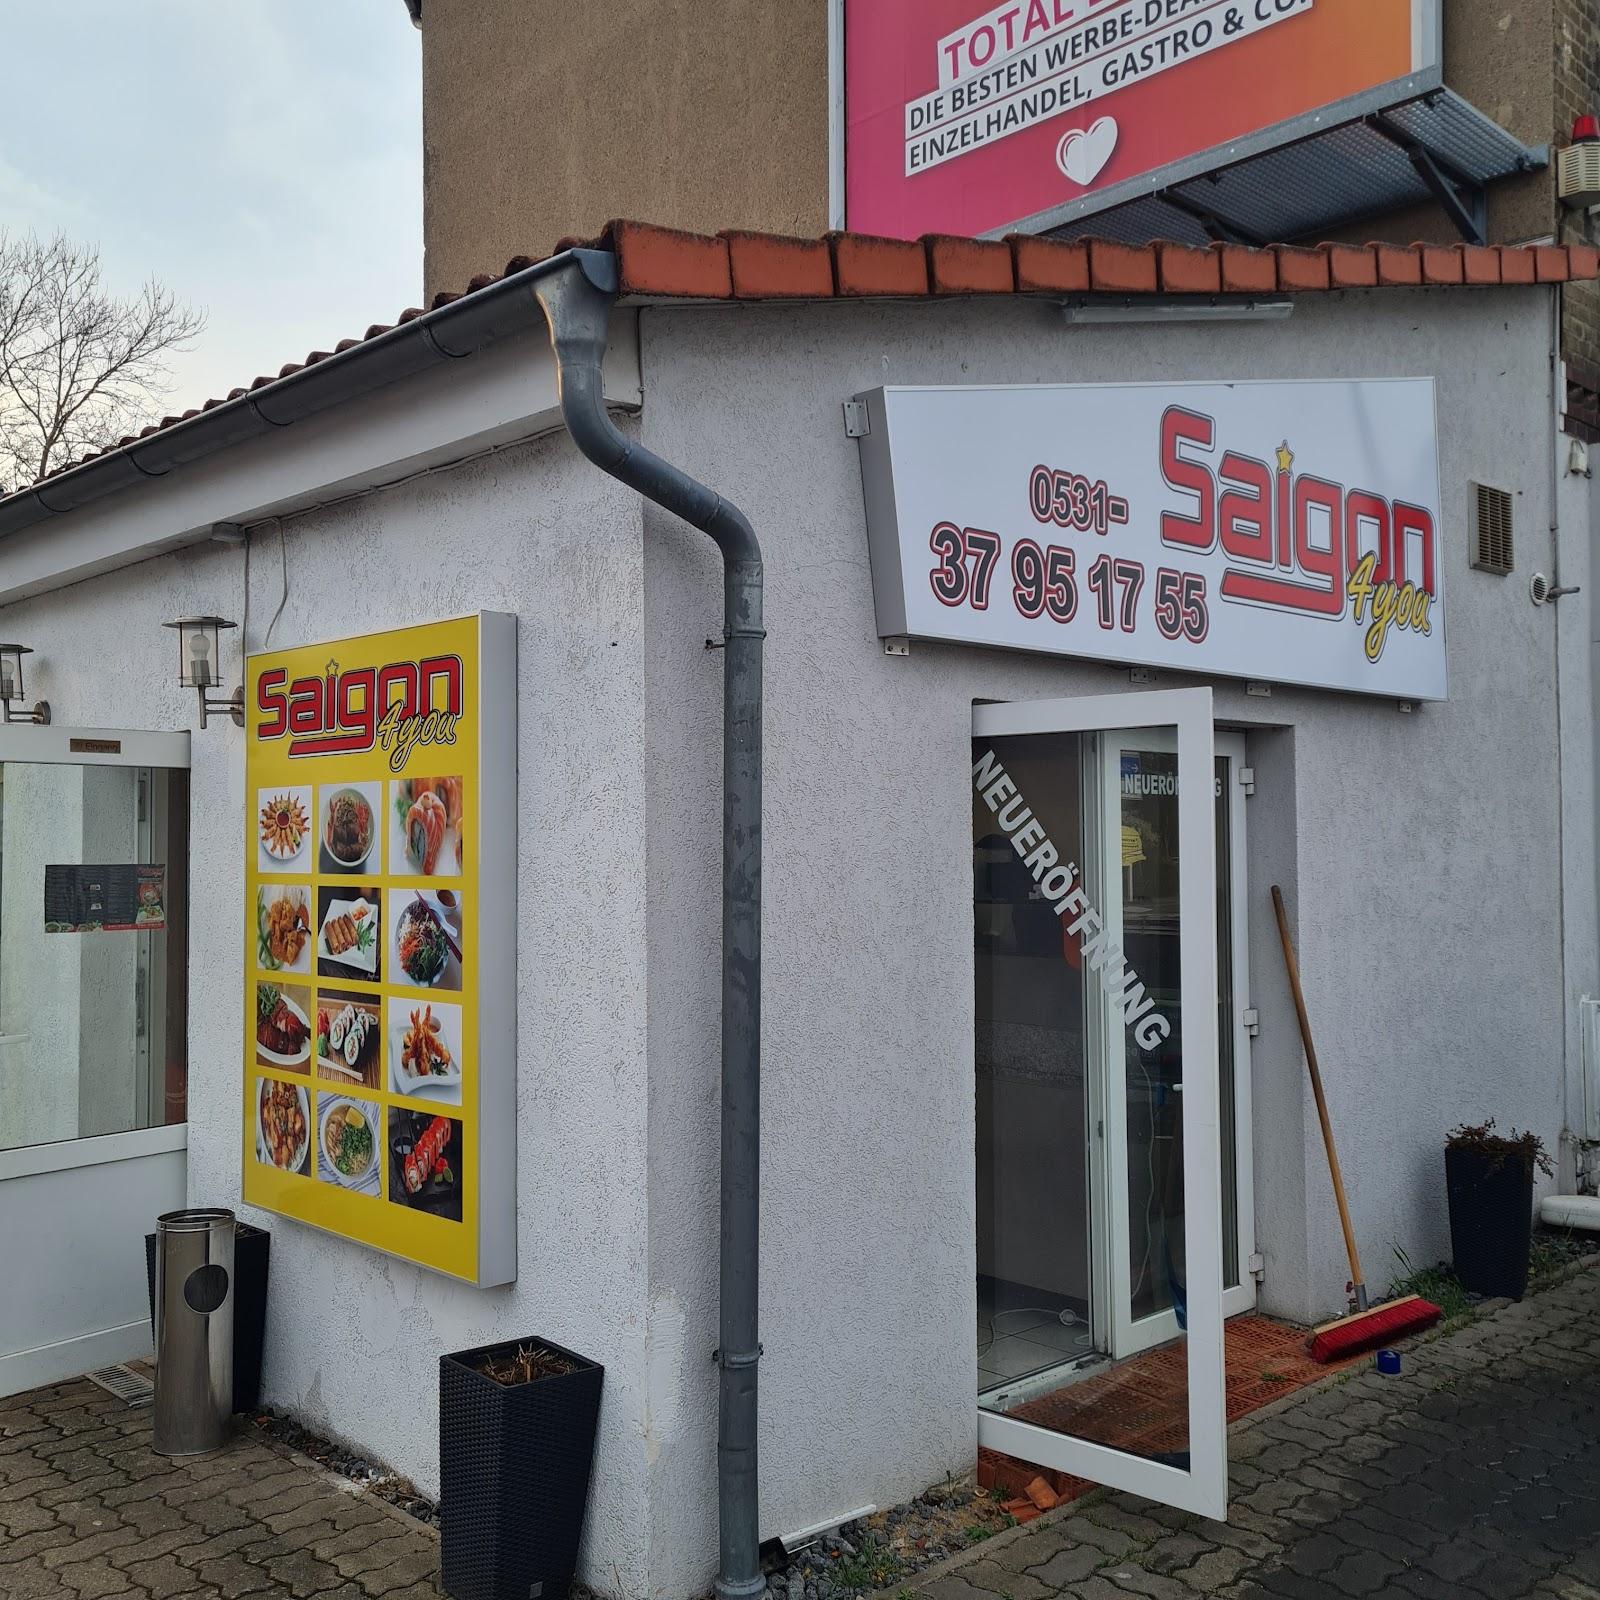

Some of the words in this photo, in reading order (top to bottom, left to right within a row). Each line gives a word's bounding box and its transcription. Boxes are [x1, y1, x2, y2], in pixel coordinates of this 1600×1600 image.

[911, 76, 1093, 168] EINZELHANDEL,
[1102, 20, 1213, 86] GASTRO
[1223, 9, 1244, 36] &
[911, 96, 944, 131] DIE
[952, 54, 1037, 113] BESTEN
[944, 0, 1074, 80] TOTAL
[1029, 464, 1129, 535] 0531-
[1159, 404, 1435, 621] Saigon
[930, 521, 1000, 610] 37
[1011, 538, 1078, 623] 95
[1089, 553, 1144, 633] 17
[1155, 568, 1209, 644] 55
[1346, 550, 1433, 664] 4you
[257, 653, 464, 759] Saigon
[377, 699, 458, 773] 4you
[972, 750, 1171, 1051] NEUERÖFFNUNG
